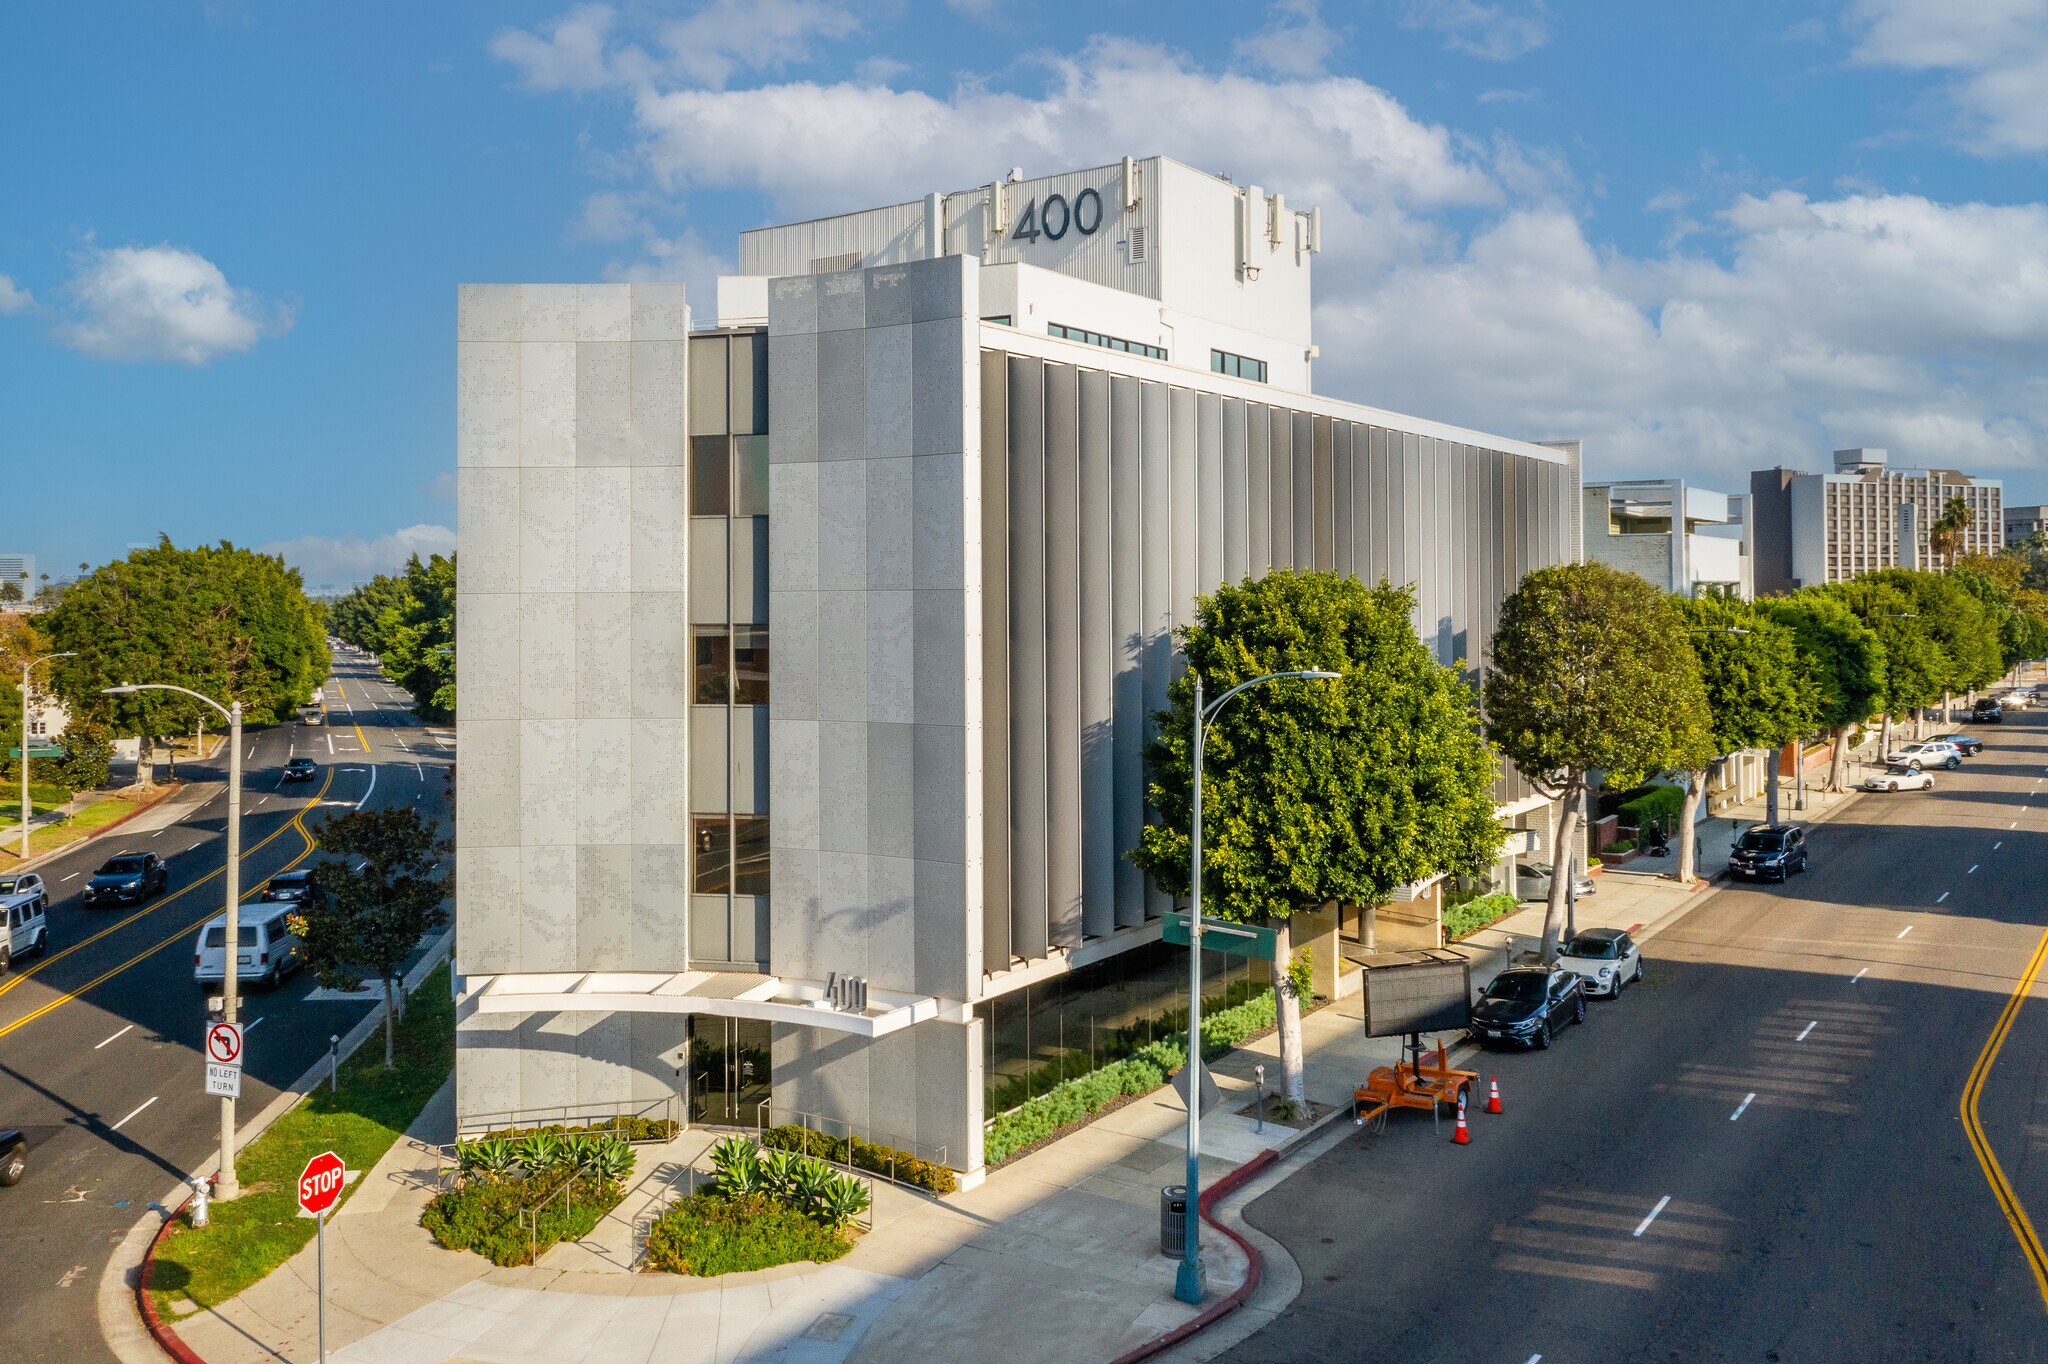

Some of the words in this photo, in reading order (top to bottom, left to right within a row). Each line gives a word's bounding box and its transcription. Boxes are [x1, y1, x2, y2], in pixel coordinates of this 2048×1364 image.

[1012, 188, 1103, 244] 400
[823, 972, 867, 1013] 400
[209, 1067, 217, 1077] NO
[220, 1068, 238, 1080] LEFT
[212, 1081, 234, 1092] TURN
[302, 1166, 342, 1200] STOP
